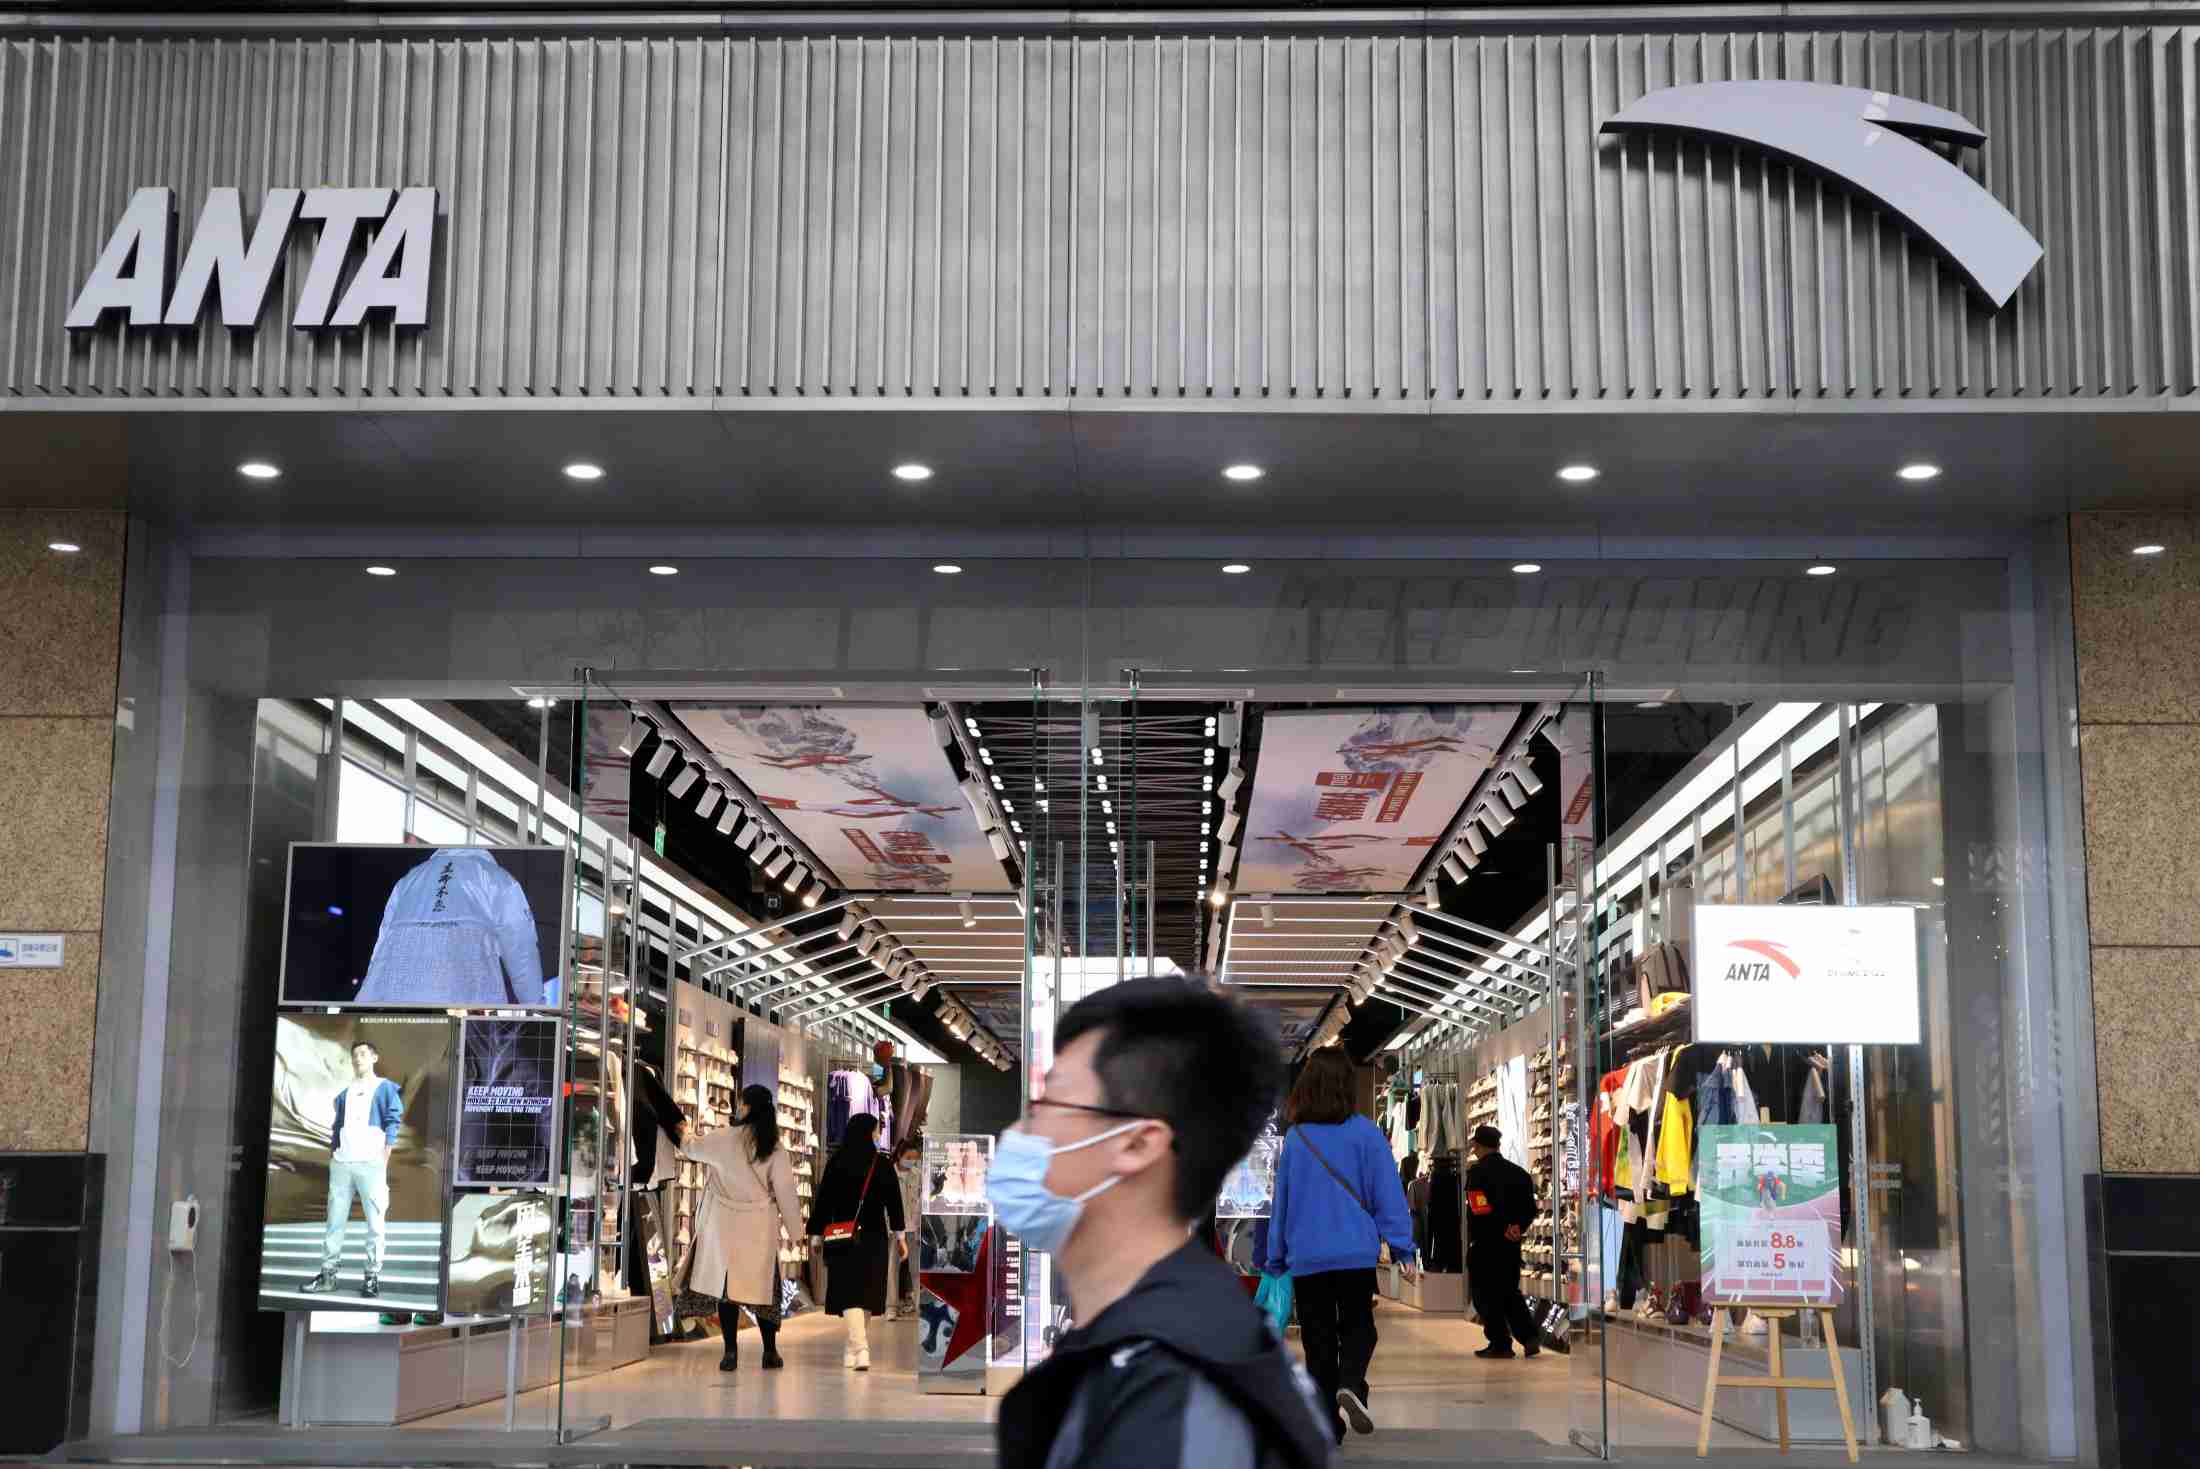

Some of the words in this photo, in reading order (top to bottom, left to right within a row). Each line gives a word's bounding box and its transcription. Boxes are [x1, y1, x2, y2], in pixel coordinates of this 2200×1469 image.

[65, 186, 439, 331] ANTA
[1724, 963, 1771, 982] ANTA
[467, 1086, 490, 1097] KEEP
